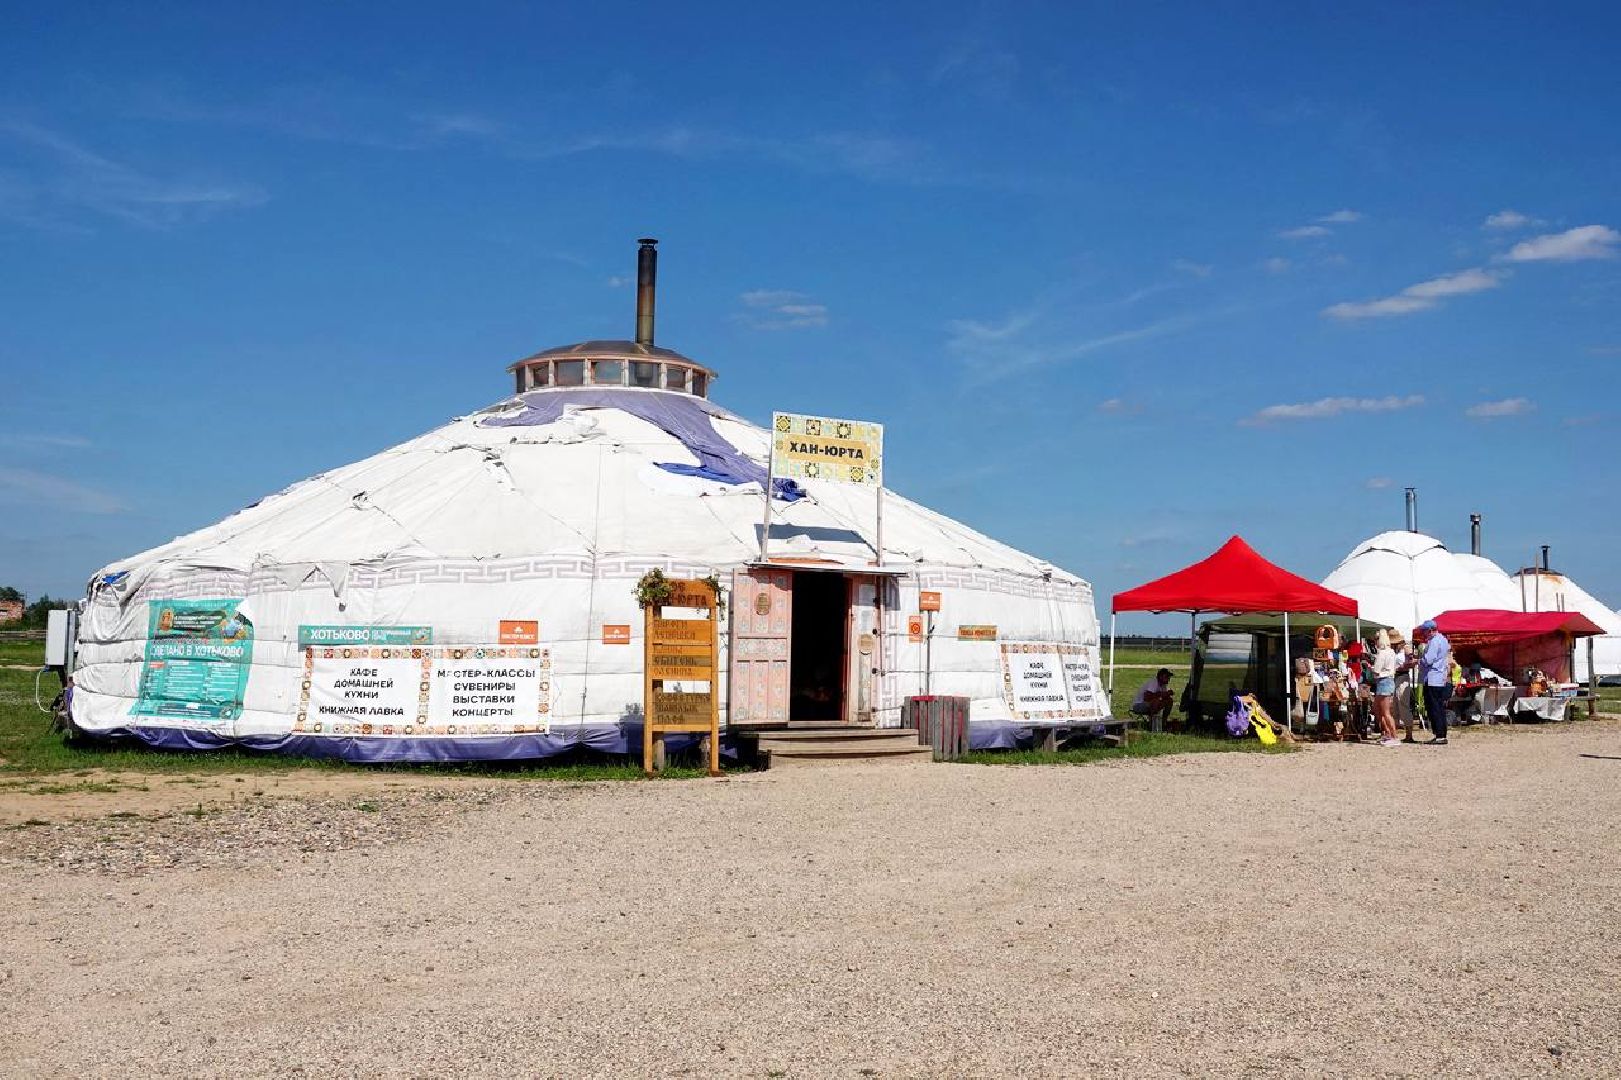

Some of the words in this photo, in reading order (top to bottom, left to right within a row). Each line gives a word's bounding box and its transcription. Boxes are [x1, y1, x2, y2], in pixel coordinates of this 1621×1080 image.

[789, 442, 864, 460] ХАН-ЮРТА
[310, 629, 370, 641] ХОТЬКОВО
[186, 644, 193, 656] В
[194, 644, 244, 658] ХОТЬКОВО
[349, 668, 378, 677] КАФЕ
[437, 668, 536, 678] МСТЕР-КЛАССЫ
[333, 678, 394, 688] ДОМАШНЕЙ
[453, 682, 516, 691] СУВЕНИРЫ
[344, 690, 379, 699] КУХНИ
[452, 695, 515, 704] ВЫСТАВКИ
[318, 705, 366, 715] КНИЖНАЯ
[368, 706, 404, 716] ЛАВКА
[452, 708, 513, 717] КОНЦЕРТЫ
